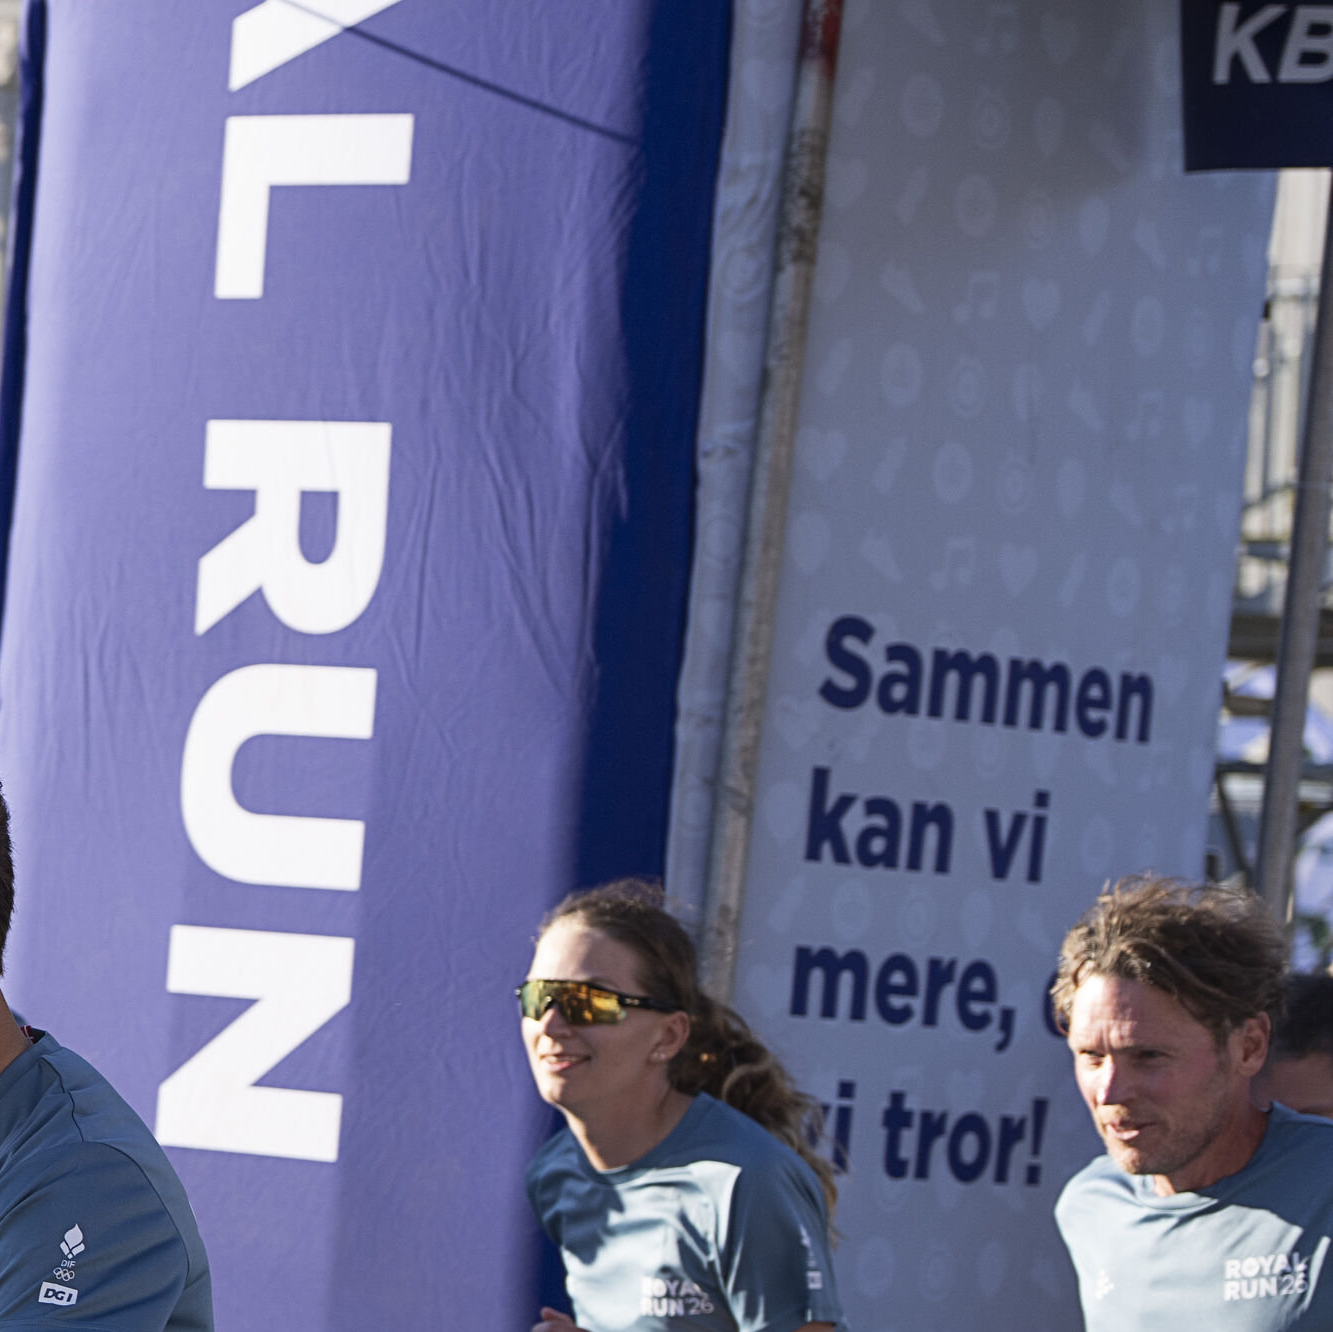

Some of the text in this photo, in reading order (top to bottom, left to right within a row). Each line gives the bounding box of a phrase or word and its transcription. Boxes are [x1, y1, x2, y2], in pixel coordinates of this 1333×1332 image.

[818, 615, 1153, 744] Sammen
[153, 419, 392, 1163] RUN
[804, 766, 1051, 884] kan vi
[789, 944, 1016, 1053] mere,
[881, 1090, 1050, 1187] tror!
[44, 1288, 73, 1303] DGI
[60, 1259, 76, 1268] DIF
